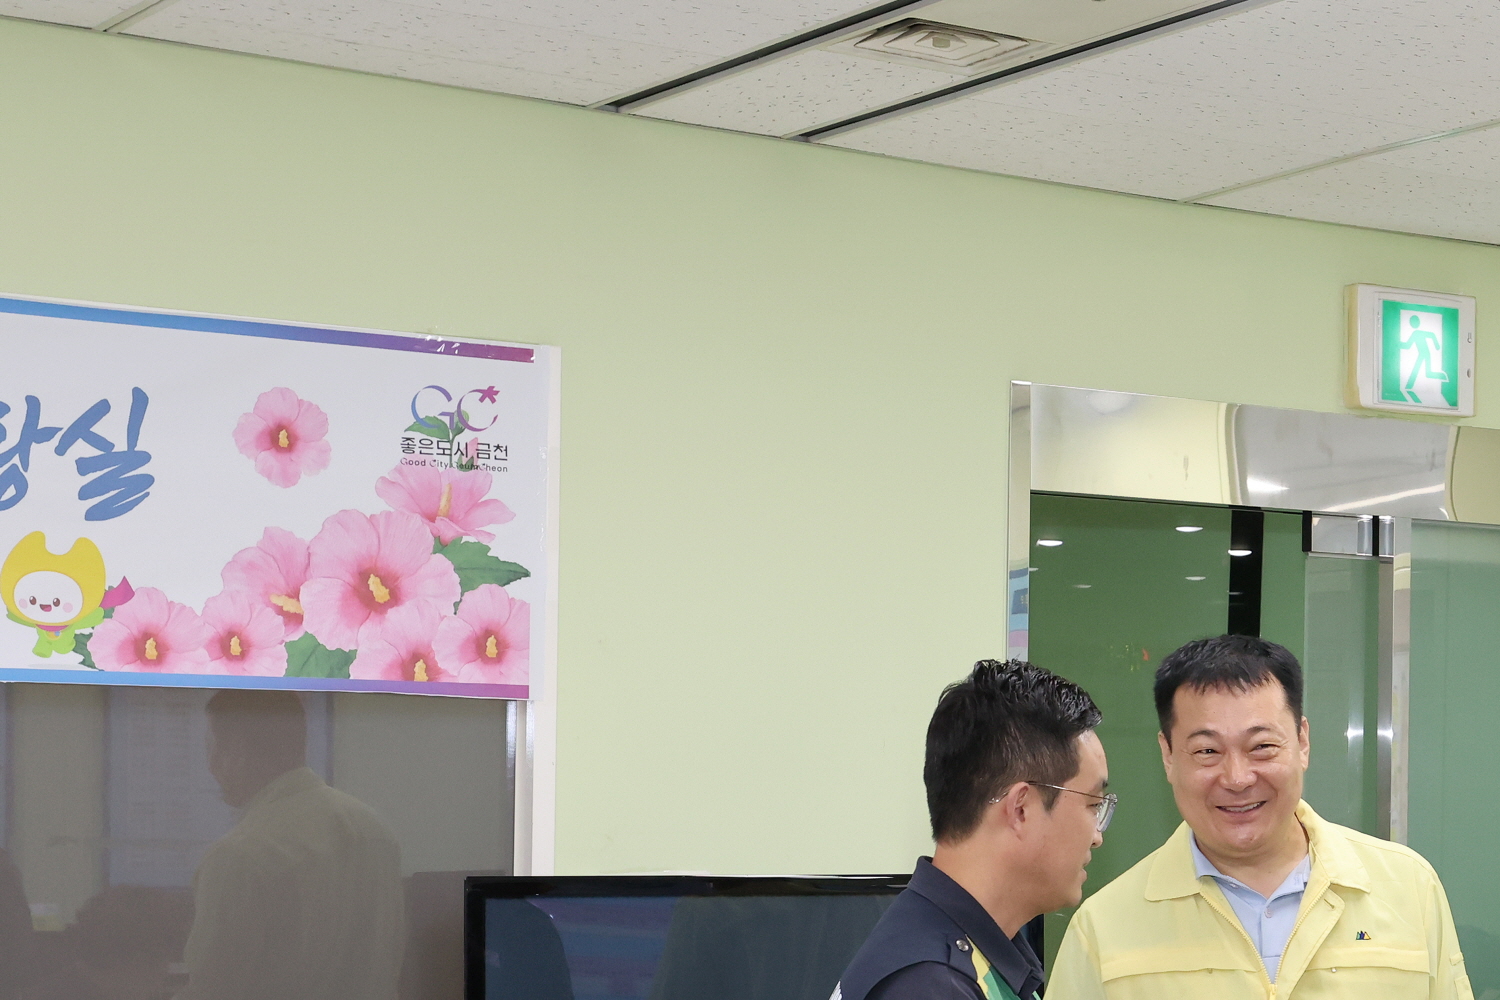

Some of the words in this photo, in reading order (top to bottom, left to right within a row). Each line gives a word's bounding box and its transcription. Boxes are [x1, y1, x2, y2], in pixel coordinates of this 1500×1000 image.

[400, 436, 468, 458] 좋은도시
[476, 442, 508, 461] 금천
[400, 457, 426, 467] Good
[429, 459, 449, 470] City
